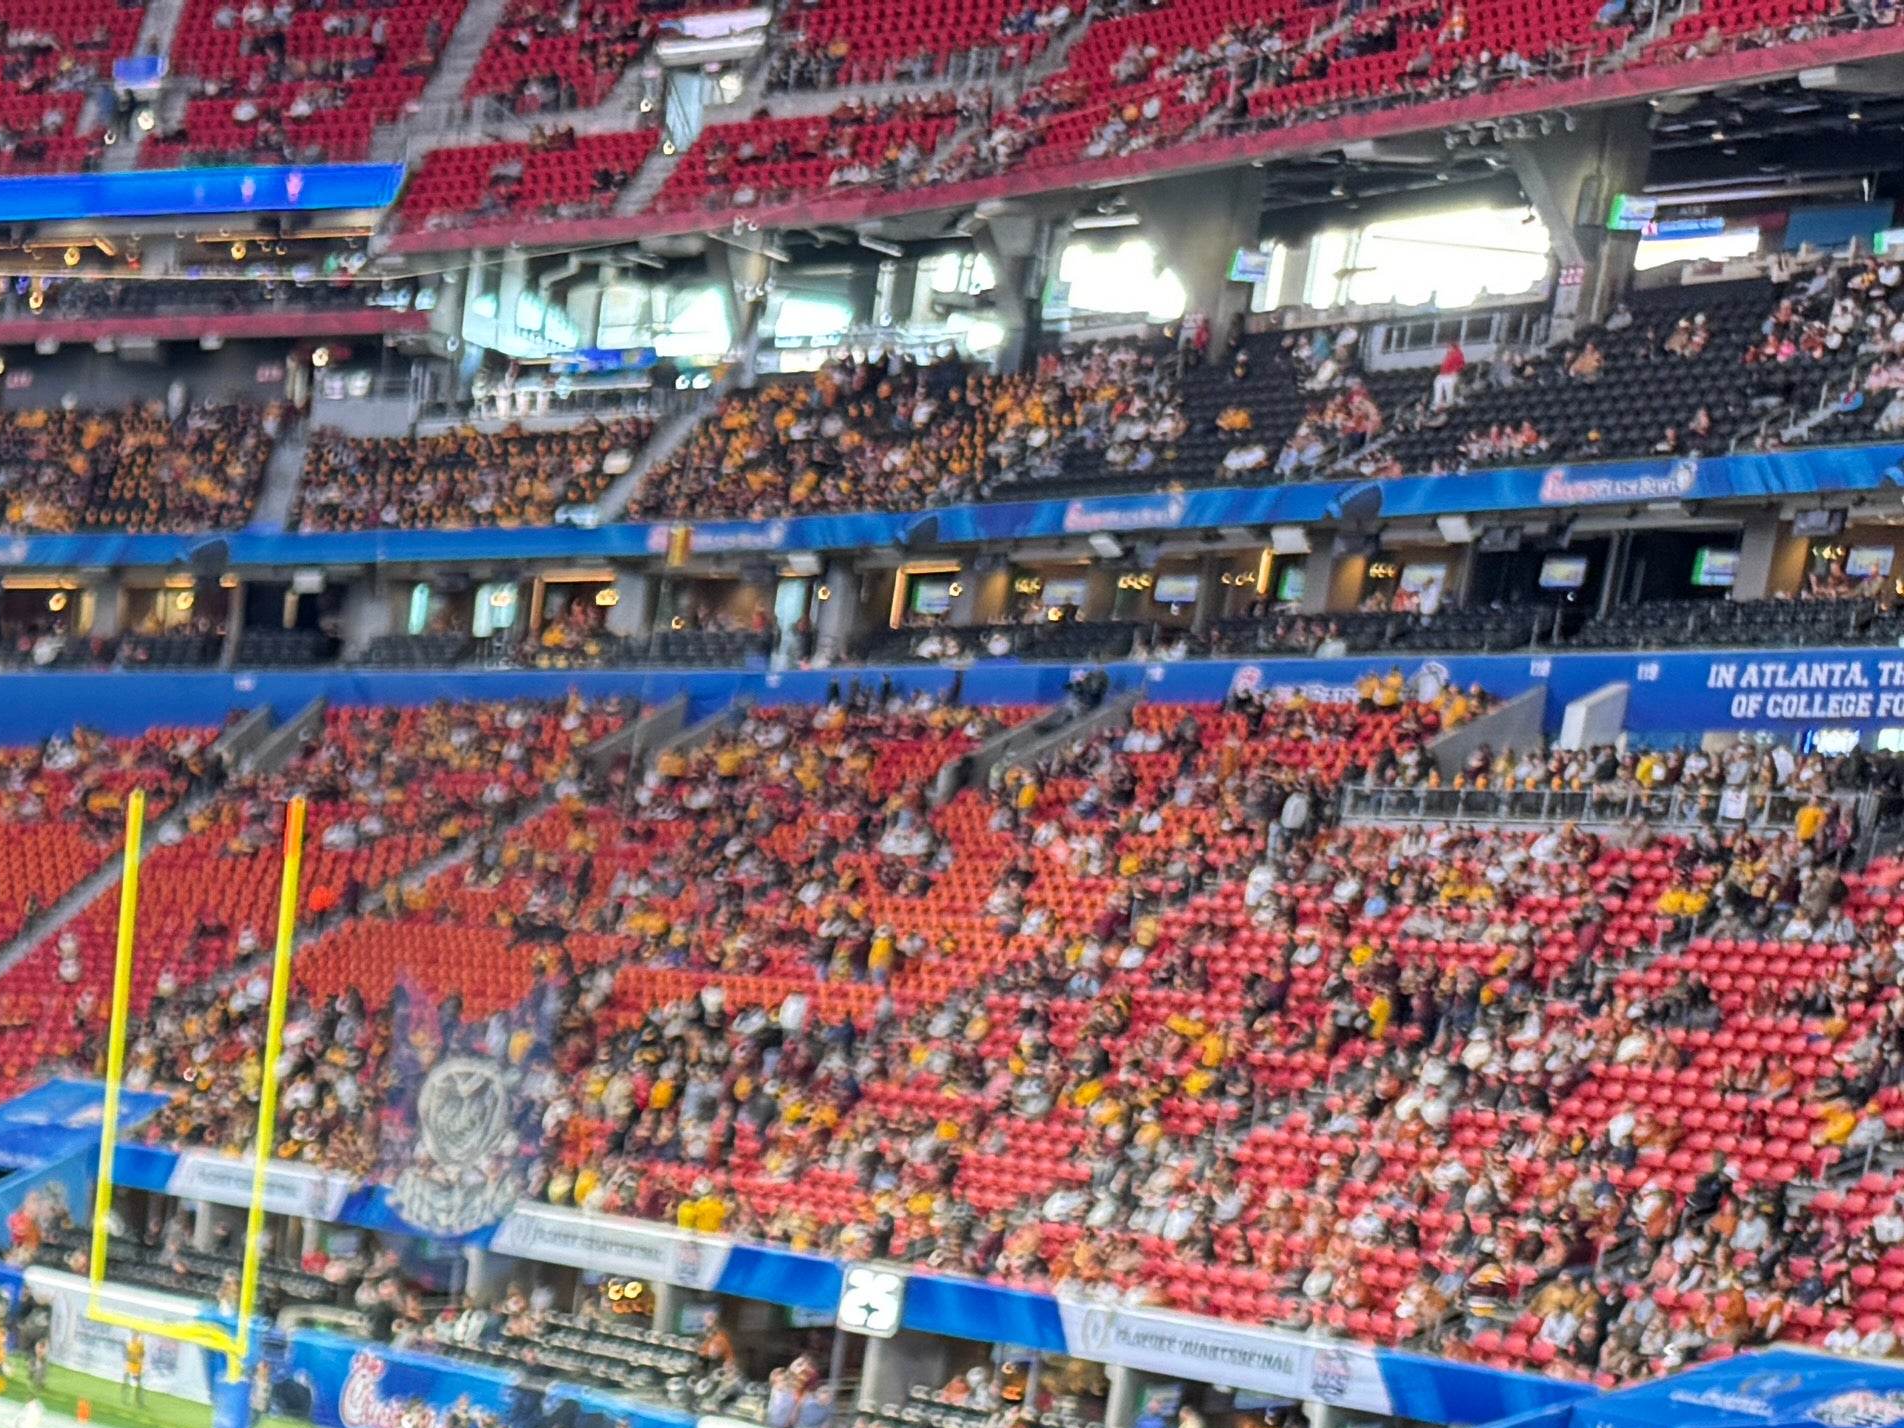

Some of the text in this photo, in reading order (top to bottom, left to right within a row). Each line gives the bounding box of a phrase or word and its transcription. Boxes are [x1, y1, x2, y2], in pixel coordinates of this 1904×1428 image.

[1707, 663, 1737, 689] IN
[1740, 661, 1869, 689] ATLANTA,
[1731, 693, 1763, 718] OF
[1766, 692, 1874, 718] COLLEGE
